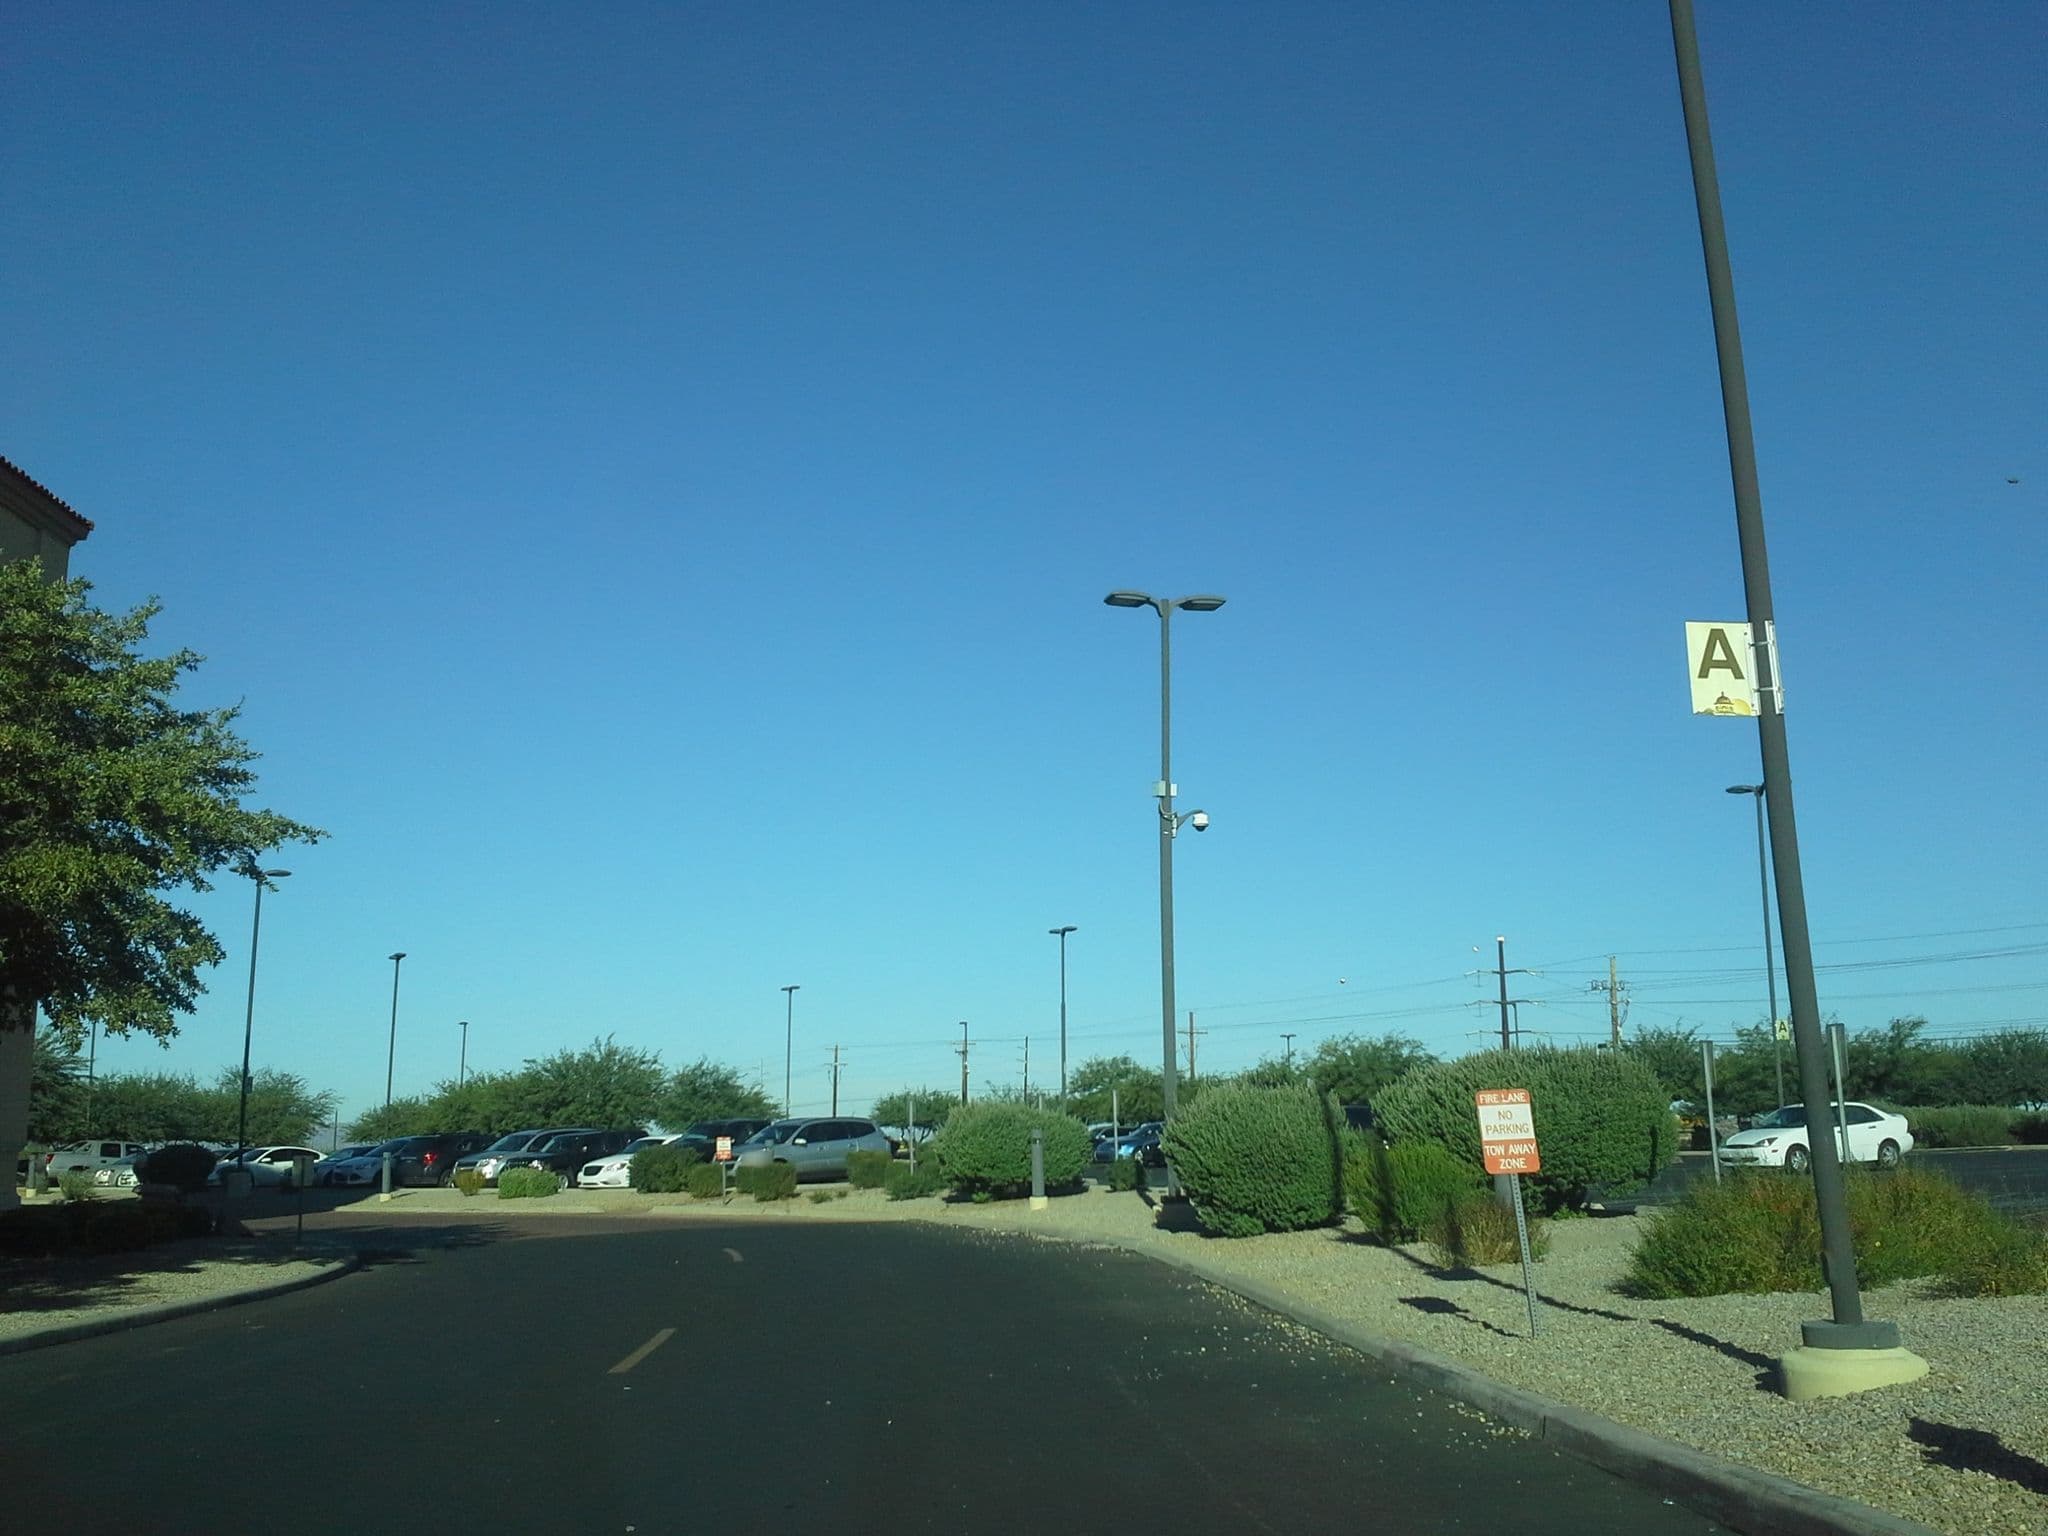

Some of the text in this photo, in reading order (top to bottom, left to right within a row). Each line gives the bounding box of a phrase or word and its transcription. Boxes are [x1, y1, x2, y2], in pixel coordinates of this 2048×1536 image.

[1697, 628, 1745, 680] A
[1778, 1021, 1787, 1033] A
[1479, 1092, 1527, 1104] FIRE LANE
[1497, 1110, 1513, 1120] NO
[1485, 1123, 1529, 1135] PARKING
[1484, 1143, 1536, 1156] TOW AWAY
[1499, 1158, 1527, 1169] ZONE
